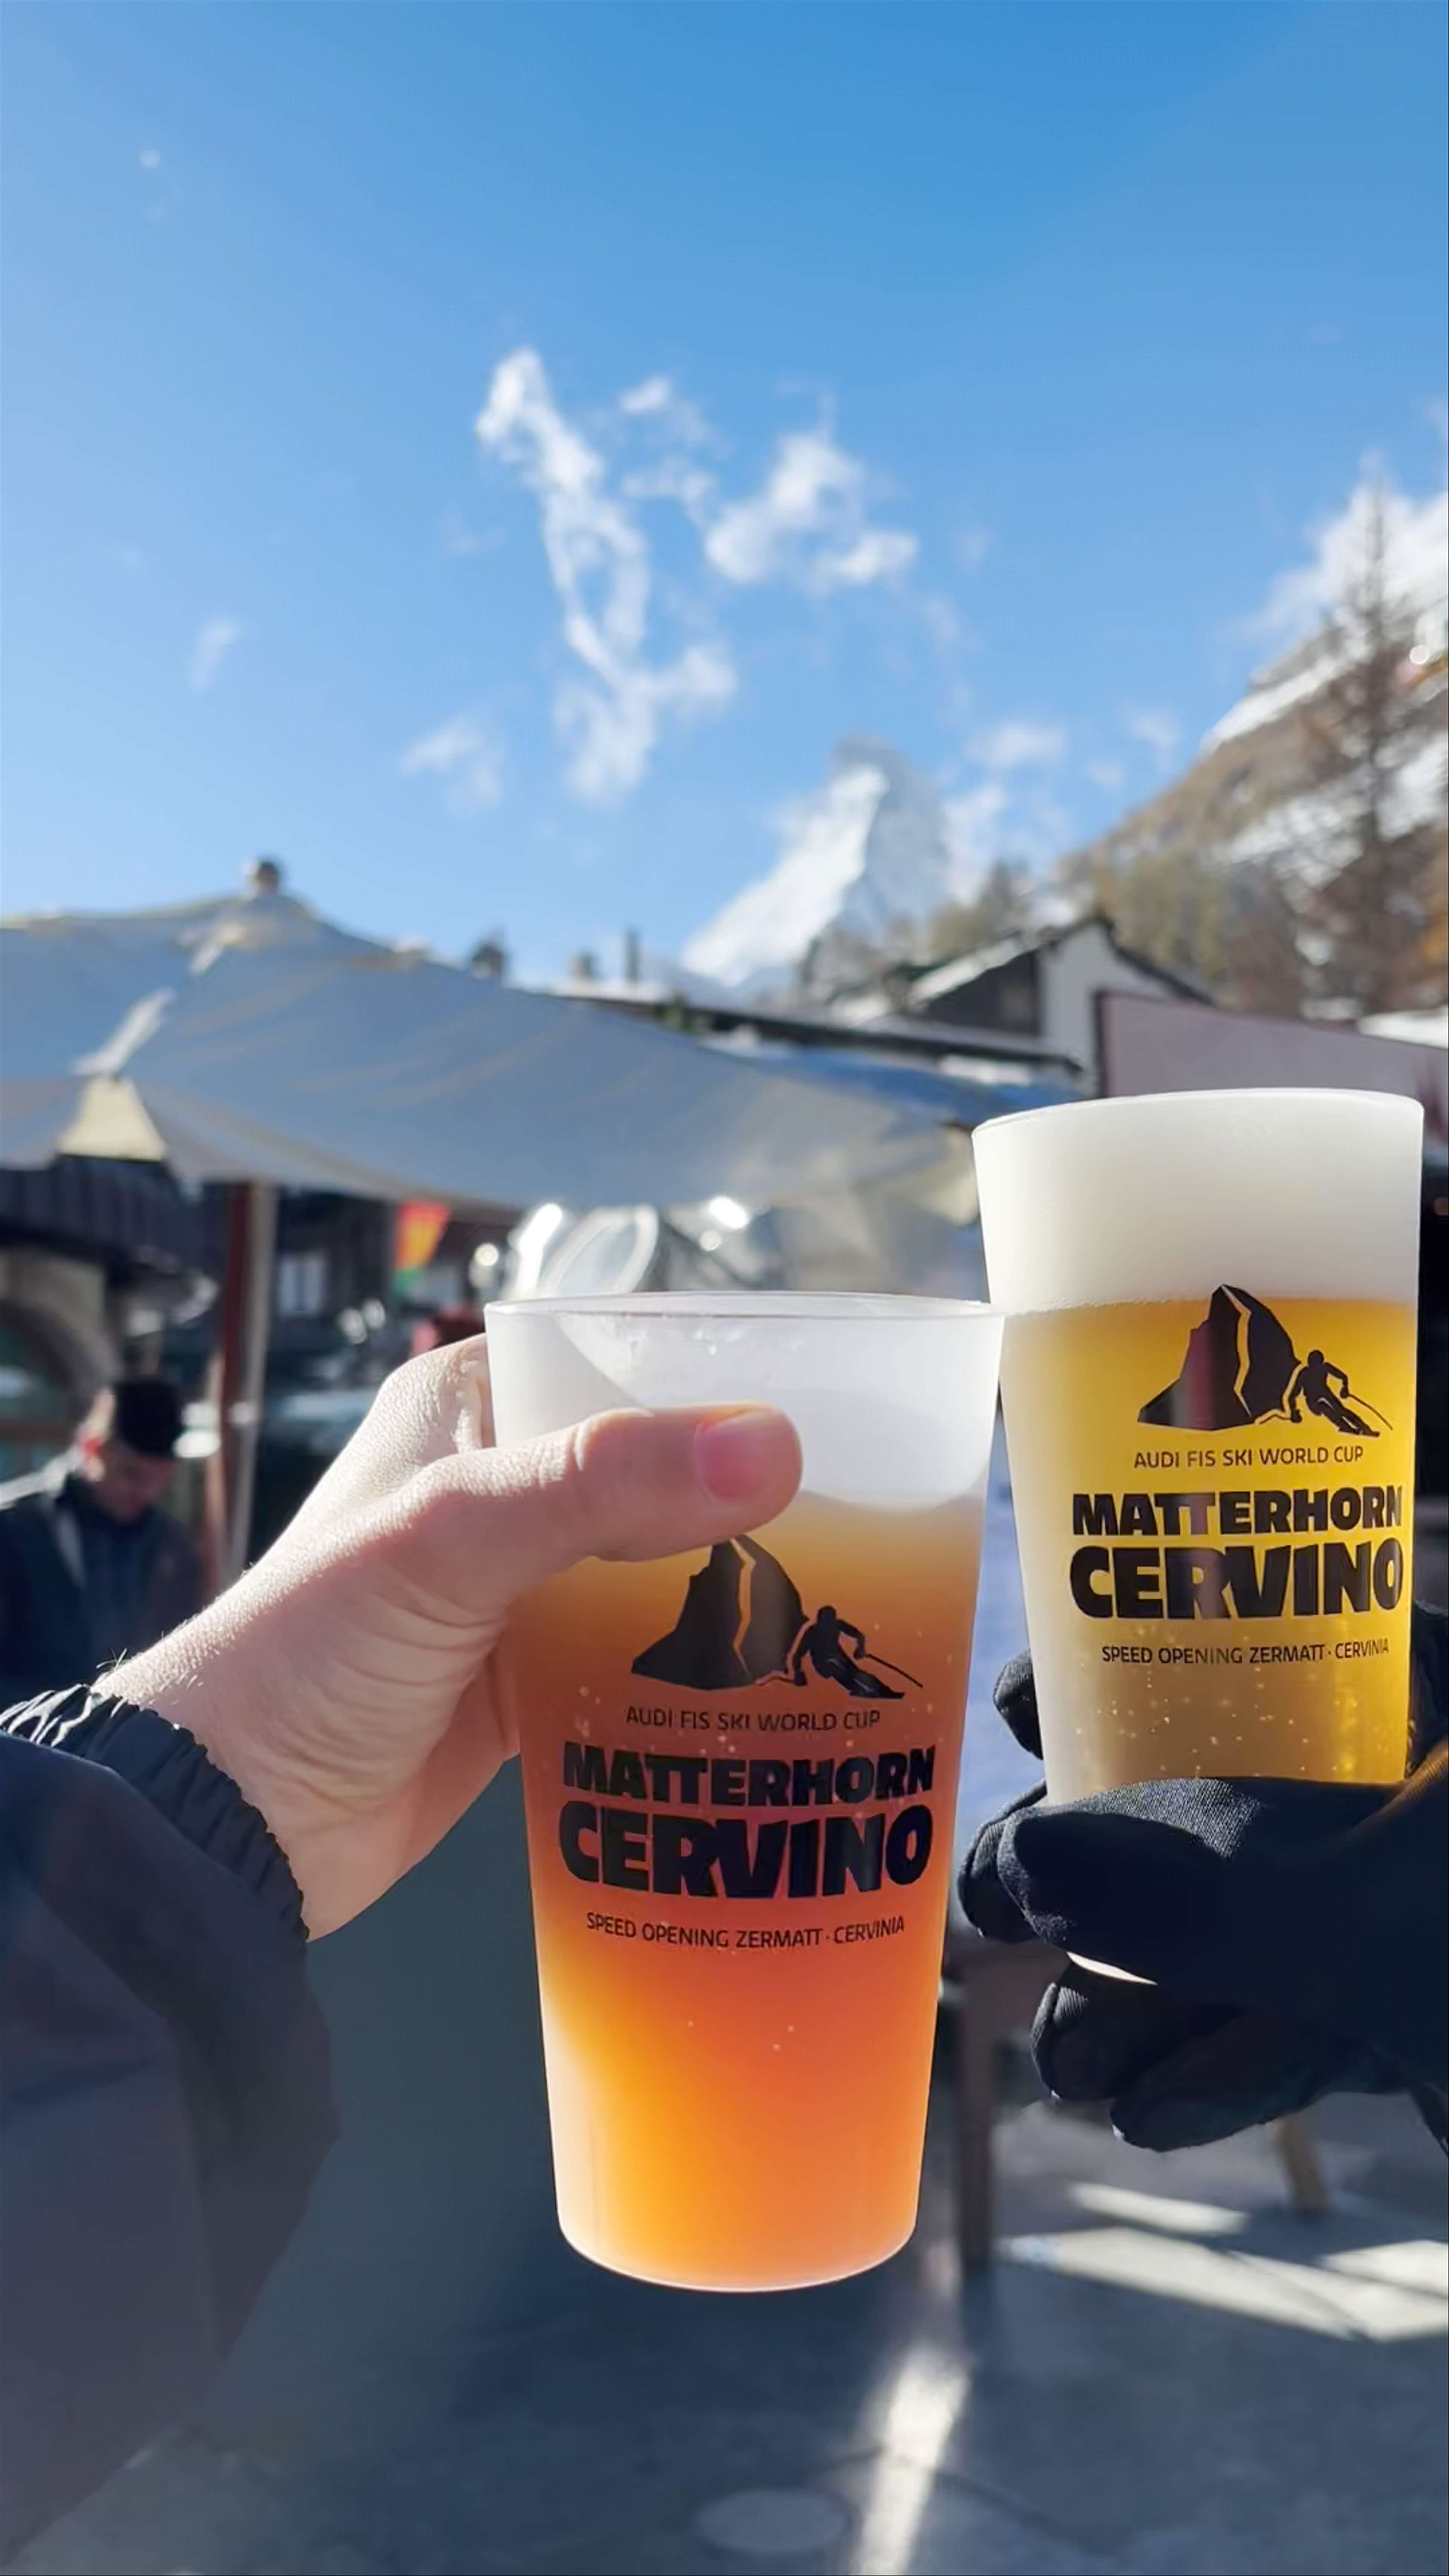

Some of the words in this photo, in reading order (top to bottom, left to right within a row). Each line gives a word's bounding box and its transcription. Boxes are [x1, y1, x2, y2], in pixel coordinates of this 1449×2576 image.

[1134, 1452, 1180, 1468] AUDI
[1187, 1450, 1216, 1467] FIS
[1223, 1448, 1252, 1466] SKI
[1260, 1447, 1328, 1464] WORLD
[1334, 1445, 1363, 1462] CUP
[1072, 1485, 1403, 1536] MATTERHORN
[1070, 1538, 1404, 1620] CERVINO
[1102, 1646, 1153, 1662] SPEED
[1158, 1646, 1243, 1663] OPENING
[1249, 1644, 1325, 1662] ZERMATT
[1335, 1638, 1389, 1659] CERVINIA
[627, 1706, 672, 1727] AUDI
[681, 1711, 711, 1729] FIS
[718, 1712, 751, 1730] SKI
[758, 1712, 837, 1731] WORLD
[843, 1710, 880, 1729] CUP
[563, 1741, 936, 1806] MATTERHORN
[559, 1801, 933, 1898] CERVINO
[587, 1912, 636, 1938] SPEED
[642, 1922, 729, 1947] OPENING
[736, 1927, 823, 1948] ZERMATT
[834, 1916, 905, 1944] CERVINIA
